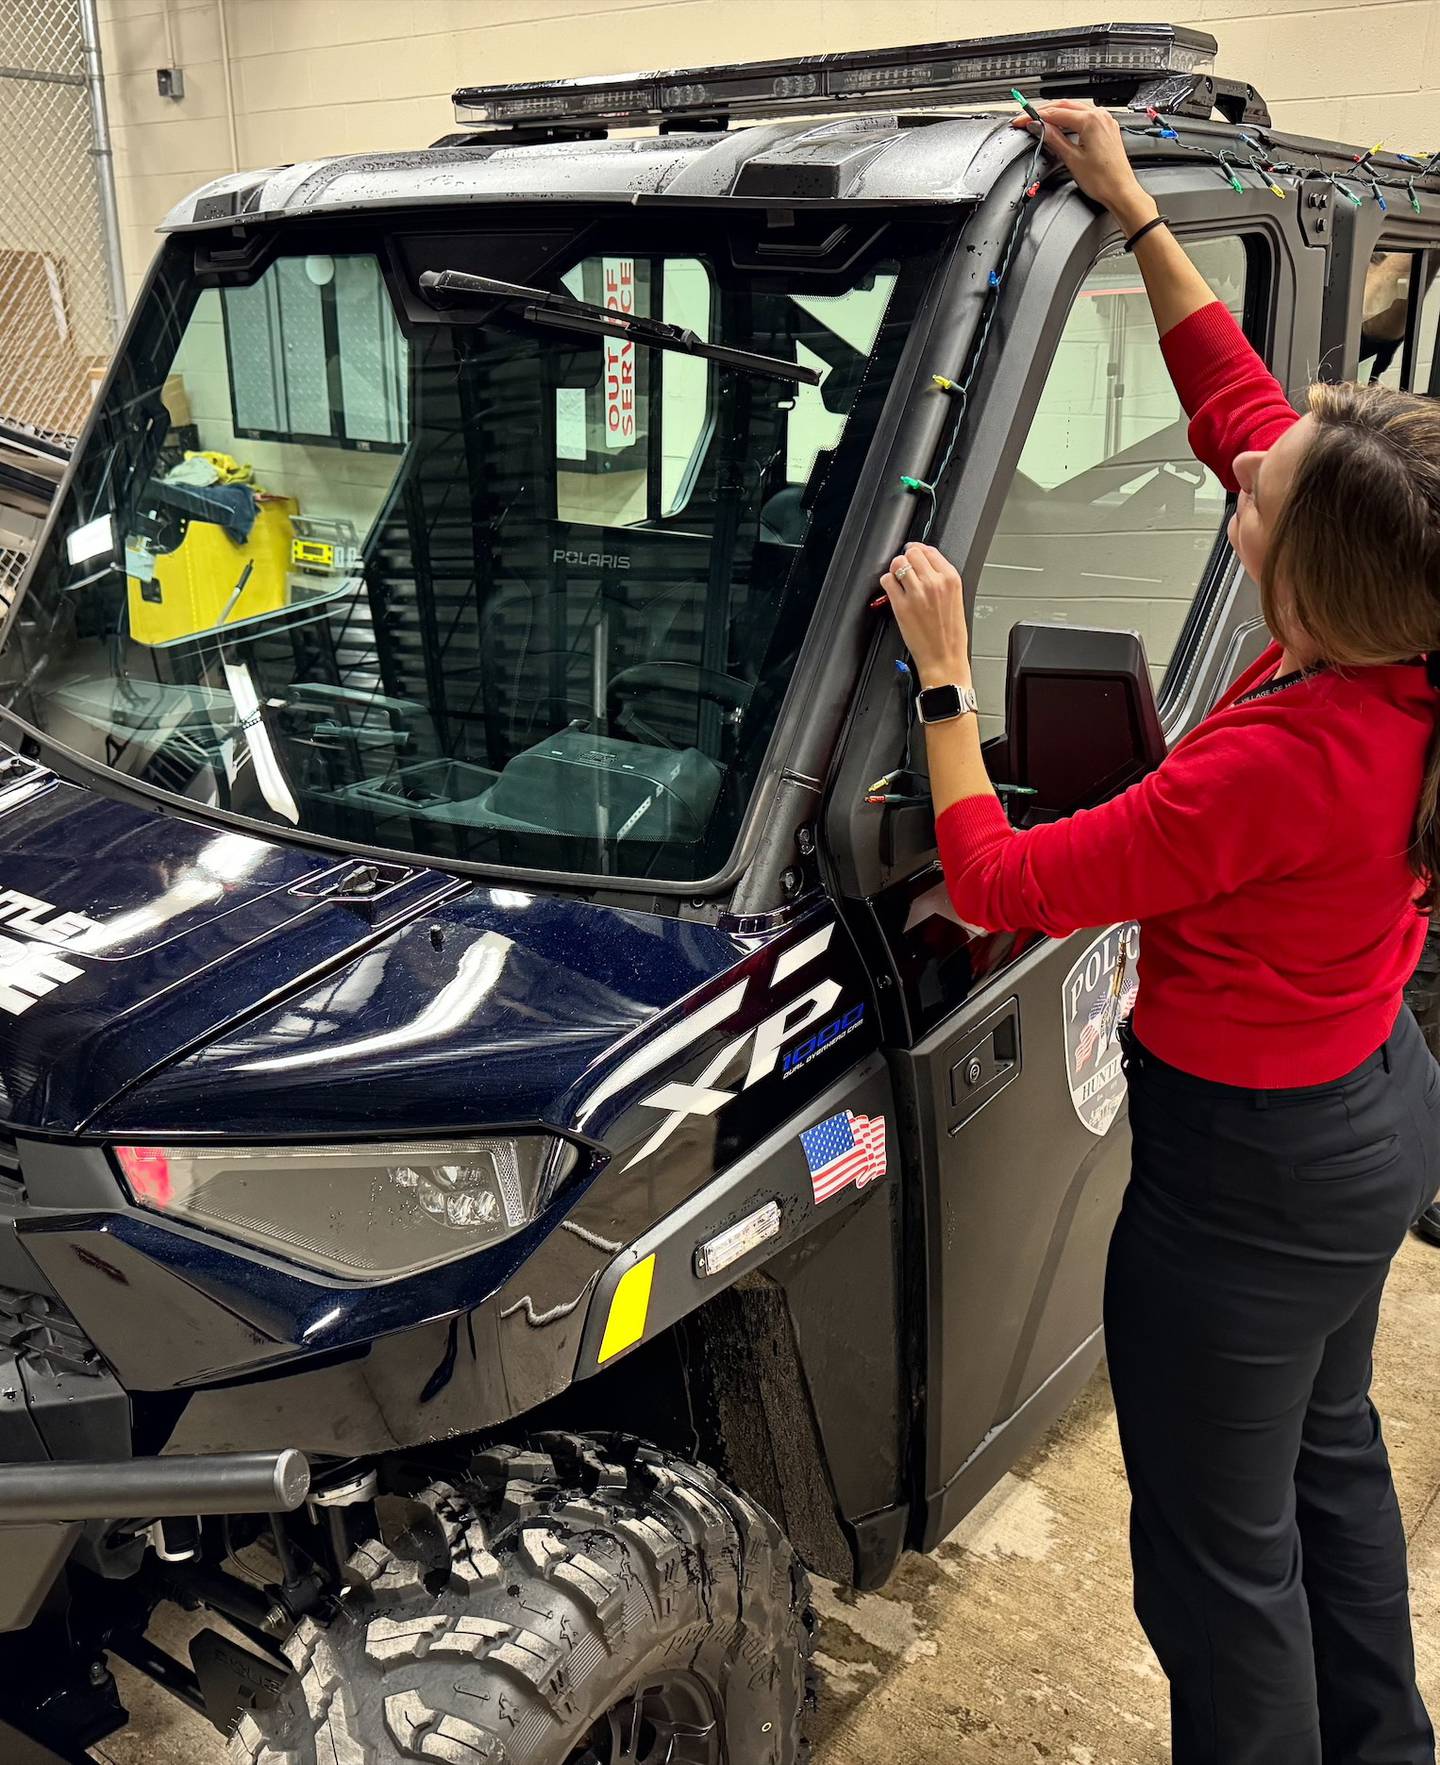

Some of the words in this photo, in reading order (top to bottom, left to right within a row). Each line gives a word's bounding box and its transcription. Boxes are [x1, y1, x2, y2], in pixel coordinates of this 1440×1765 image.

[606, 268, 618, 325] OF
[607, 346, 620, 432] OUT
[552, 549, 631, 569] POLARIS
[783, 1002, 864, 1071] 1000
[783, 1062, 805, 1080] DUAL
[806, 1031, 847, 1063] OVERHEAD
[847, 1018, 864, 1034] CAM
[618, 978, 843, 1175] XP
